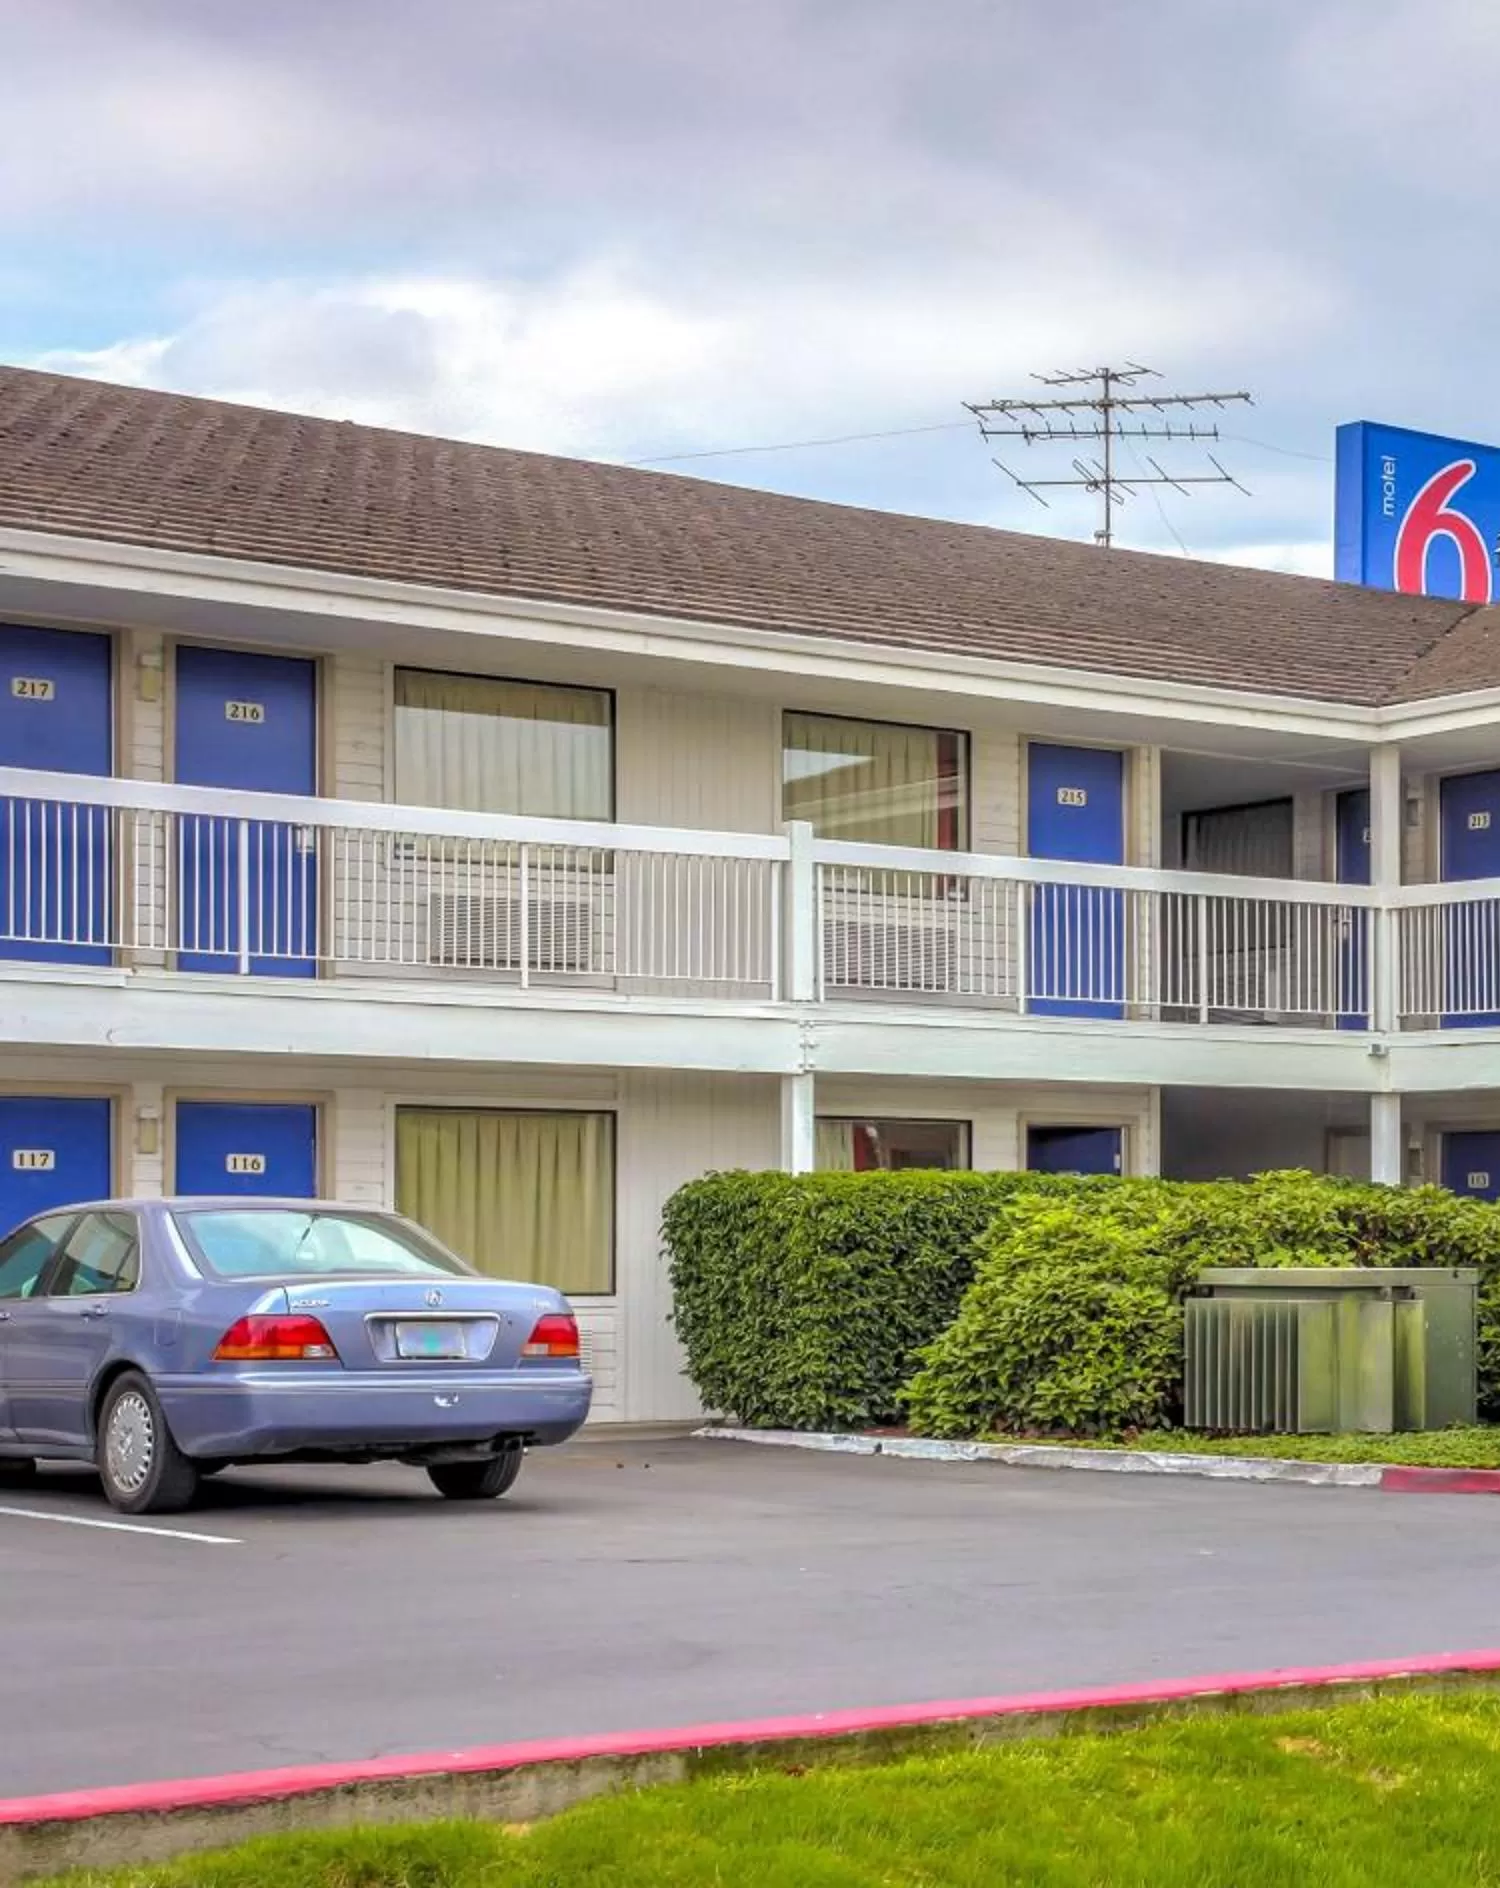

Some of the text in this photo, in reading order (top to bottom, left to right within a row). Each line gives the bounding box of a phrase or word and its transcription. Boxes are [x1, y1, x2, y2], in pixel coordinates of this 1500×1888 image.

[1380, 455, 1493, 606] motel 6
[17, 680, 49, 697] 217
[230, 703, 260, 721] 216
[1061, 790, 1084, 804] 215
[18, 1152, 49, 1167] 117
[231, 1156, 261, 1171] 116
